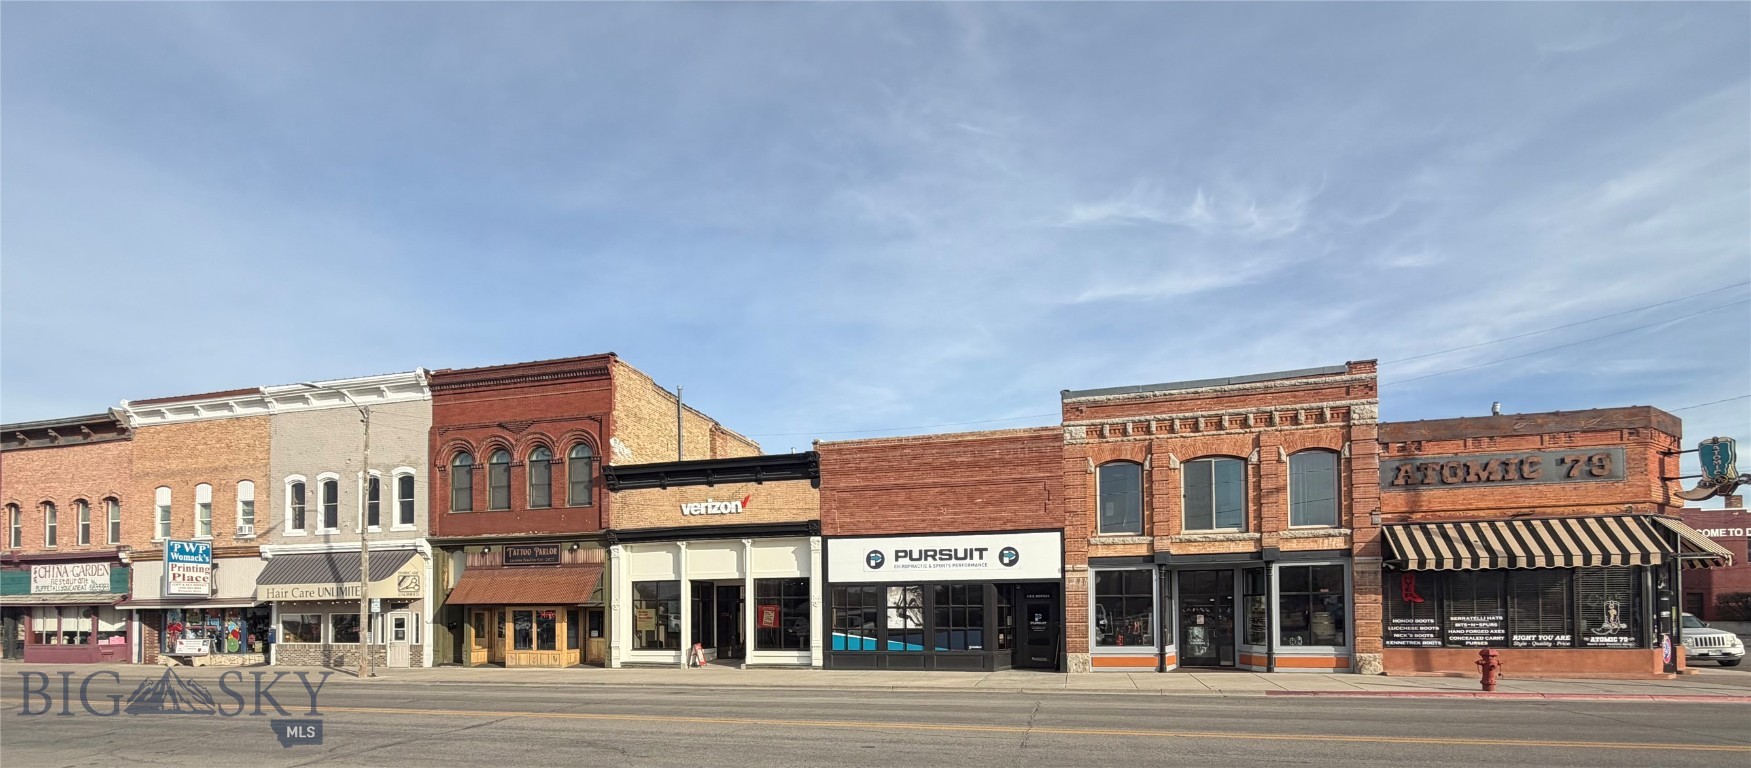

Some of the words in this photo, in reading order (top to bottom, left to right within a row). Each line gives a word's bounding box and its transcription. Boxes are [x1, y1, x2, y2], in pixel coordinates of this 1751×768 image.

[1392, 455, 1545, 486] ATOMIC
[680, 499, 743, 516] verizon
[1695, 528, 1727, 537] OME
[1728, 528, 1744, 537] TO
[170, 552, 210, 562] Womack's
[506, 547, 532, 558] TATTOO
[534, 546, 558, 557] PARLOR
[894, 547, 989, 562] PURSUIT
[38, 565, 69, 578] CHINA
[72, 564, 110, 577] GARDEN
[171, 563, 211, 575] Printing
[172, 573, 209, 582] Place
[266, 587, 289, 599] Hair
[291, 587, 315, 598] Care
[317, 585, 361, 597] UNLIMITE
